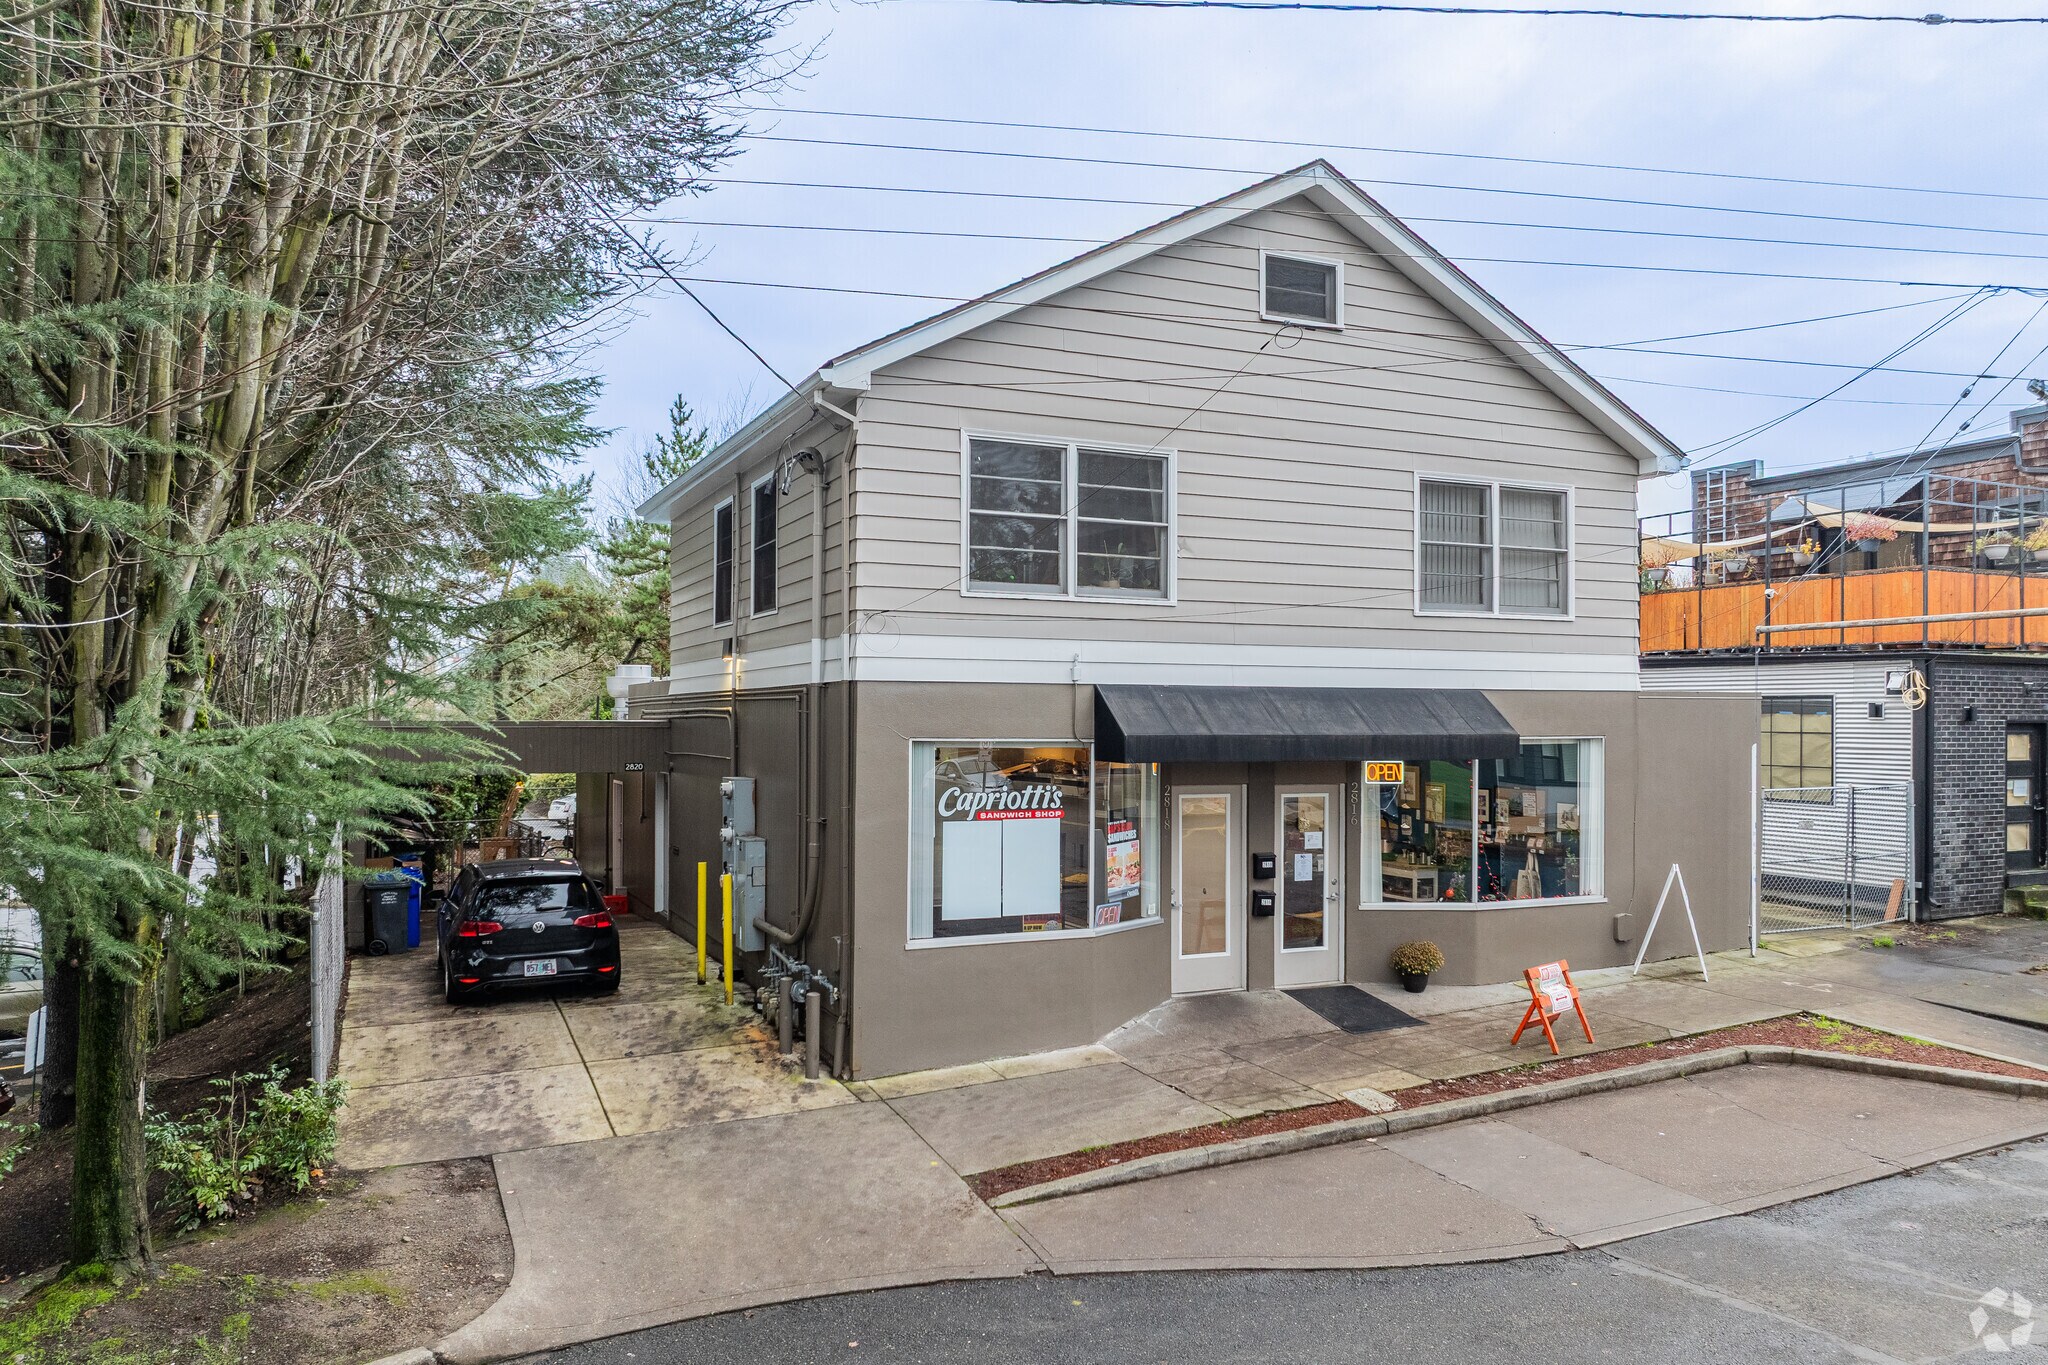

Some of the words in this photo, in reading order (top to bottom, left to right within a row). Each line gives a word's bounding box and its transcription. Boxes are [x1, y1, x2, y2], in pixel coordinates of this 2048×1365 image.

[625, 763, 644, 771] 2820
[1367, 764, 1402, 781] OPEN
[938, 784, 1063, 821] Capriotti's
[1350, 782, 1359, 826] 2816
[980, 811, 1032, 819] SANDWICH
[1098, 905, 1120, 927] OPEN
